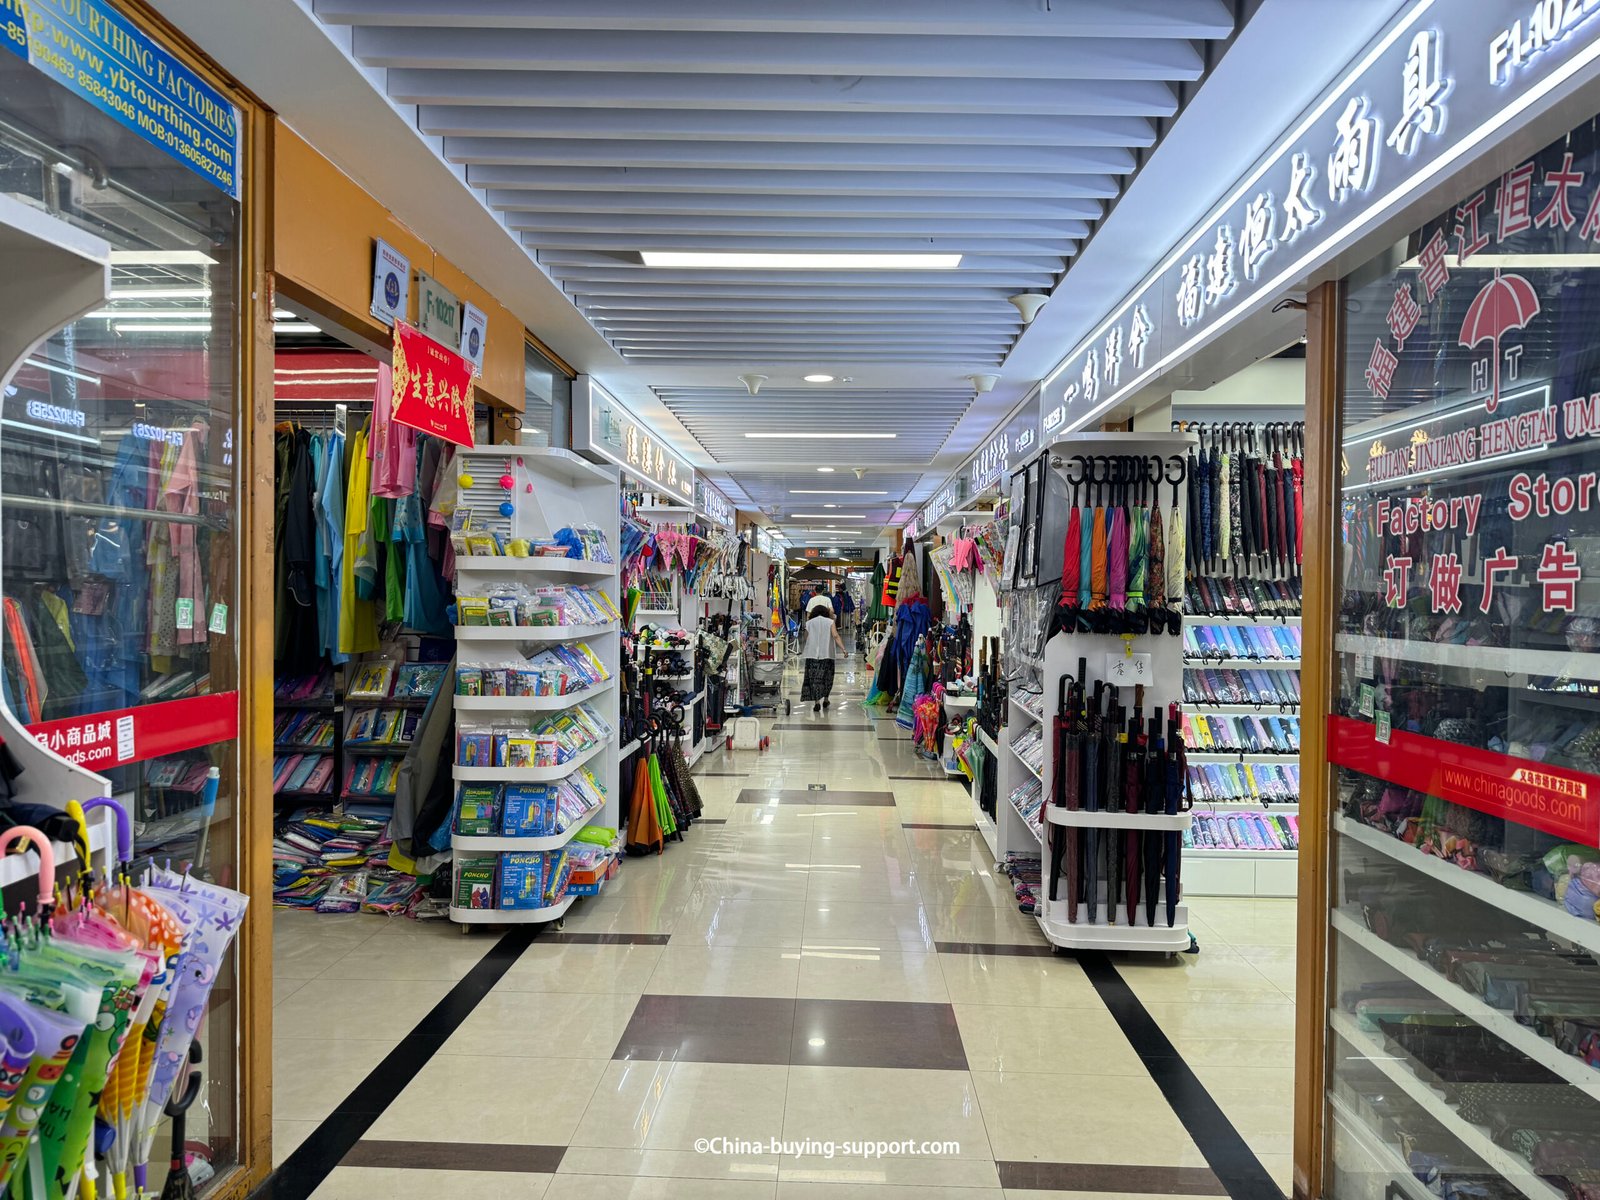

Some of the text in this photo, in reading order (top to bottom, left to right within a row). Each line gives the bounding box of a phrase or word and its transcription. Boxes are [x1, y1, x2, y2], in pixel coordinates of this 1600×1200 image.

[78, 69, 136, 121] 85843046
[157, 58, 236, 139] FACTORIES
[1176, 30, 1444, 327] 福建恒太雨具
[409, 362, 464, 420] 生意兴隆
[1368, 392, 1600, 483] FUJIAN JINJIANG HENGTAI UM
[1376, 471, 1600, 538] Factory Stor
[1383, 541, 1581, 615] 订做广告
[1444, 769, 1582, 823] www.chinagoods.com
[463, 871, 490, 879] PONCHO
